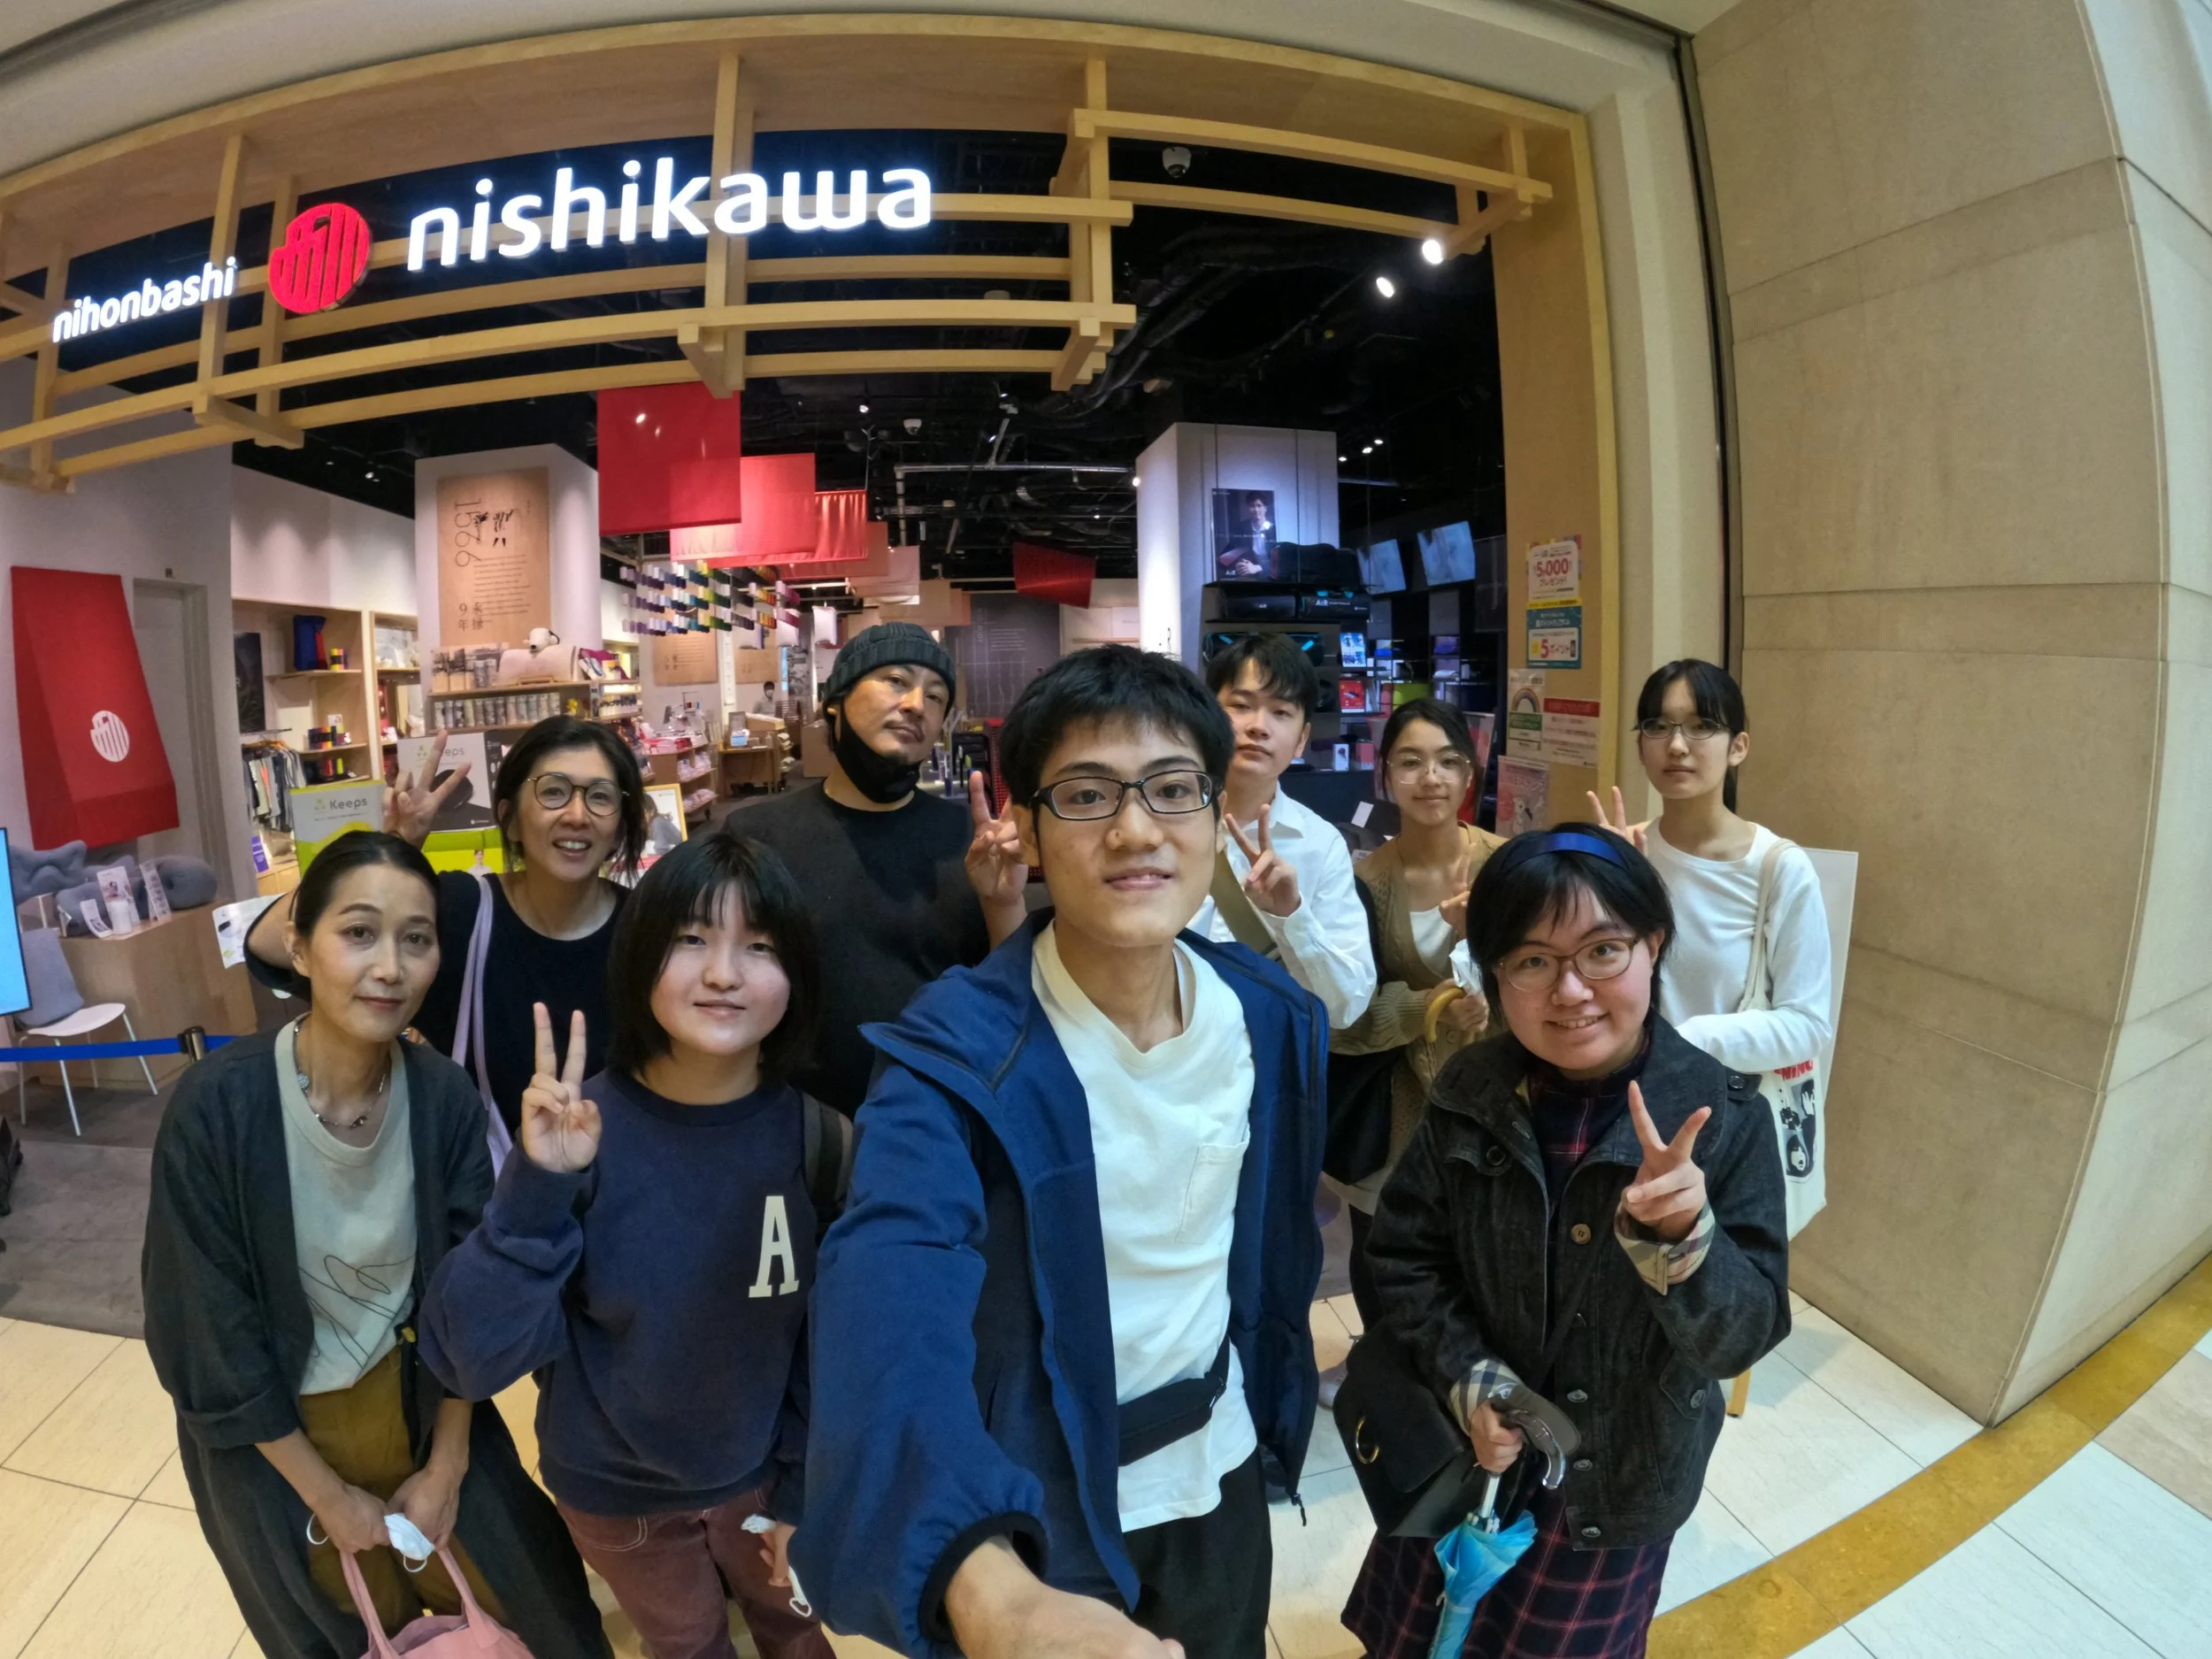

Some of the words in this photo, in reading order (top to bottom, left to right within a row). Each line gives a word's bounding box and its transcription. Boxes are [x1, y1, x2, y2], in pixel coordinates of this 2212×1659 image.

[406, 157, 933, 273] nishikawa
[52, 256, 238, 343] nihonbashi
[454, 497, 482, 567] 1566
[329, 797, 368, 810] Keeps
[748, 1194, 800, 1299] A
